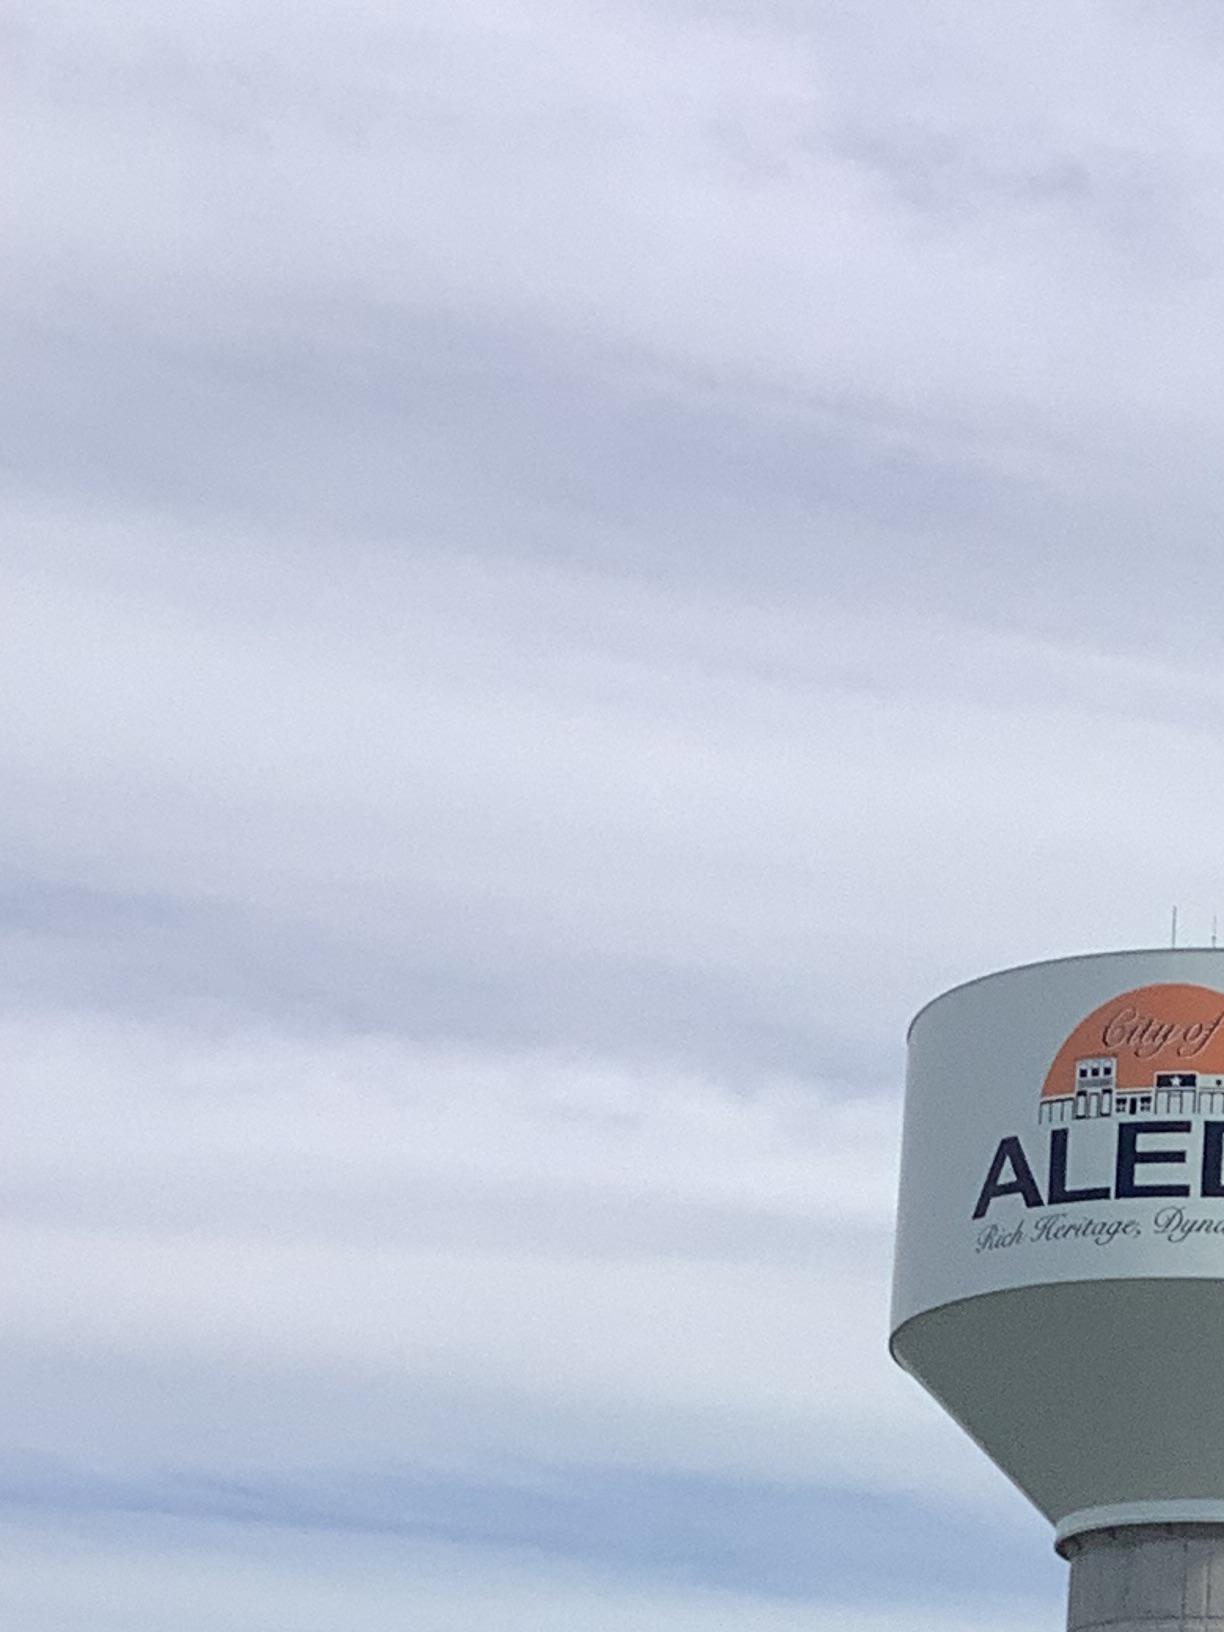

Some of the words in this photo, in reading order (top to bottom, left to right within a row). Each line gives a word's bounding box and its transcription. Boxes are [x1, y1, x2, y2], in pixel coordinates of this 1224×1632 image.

[1102, 1006, 1179, 1058] City
[976, 1220, 1024, 1254] Rich
[1030, 1213, 1142, 1248] Heritage,
